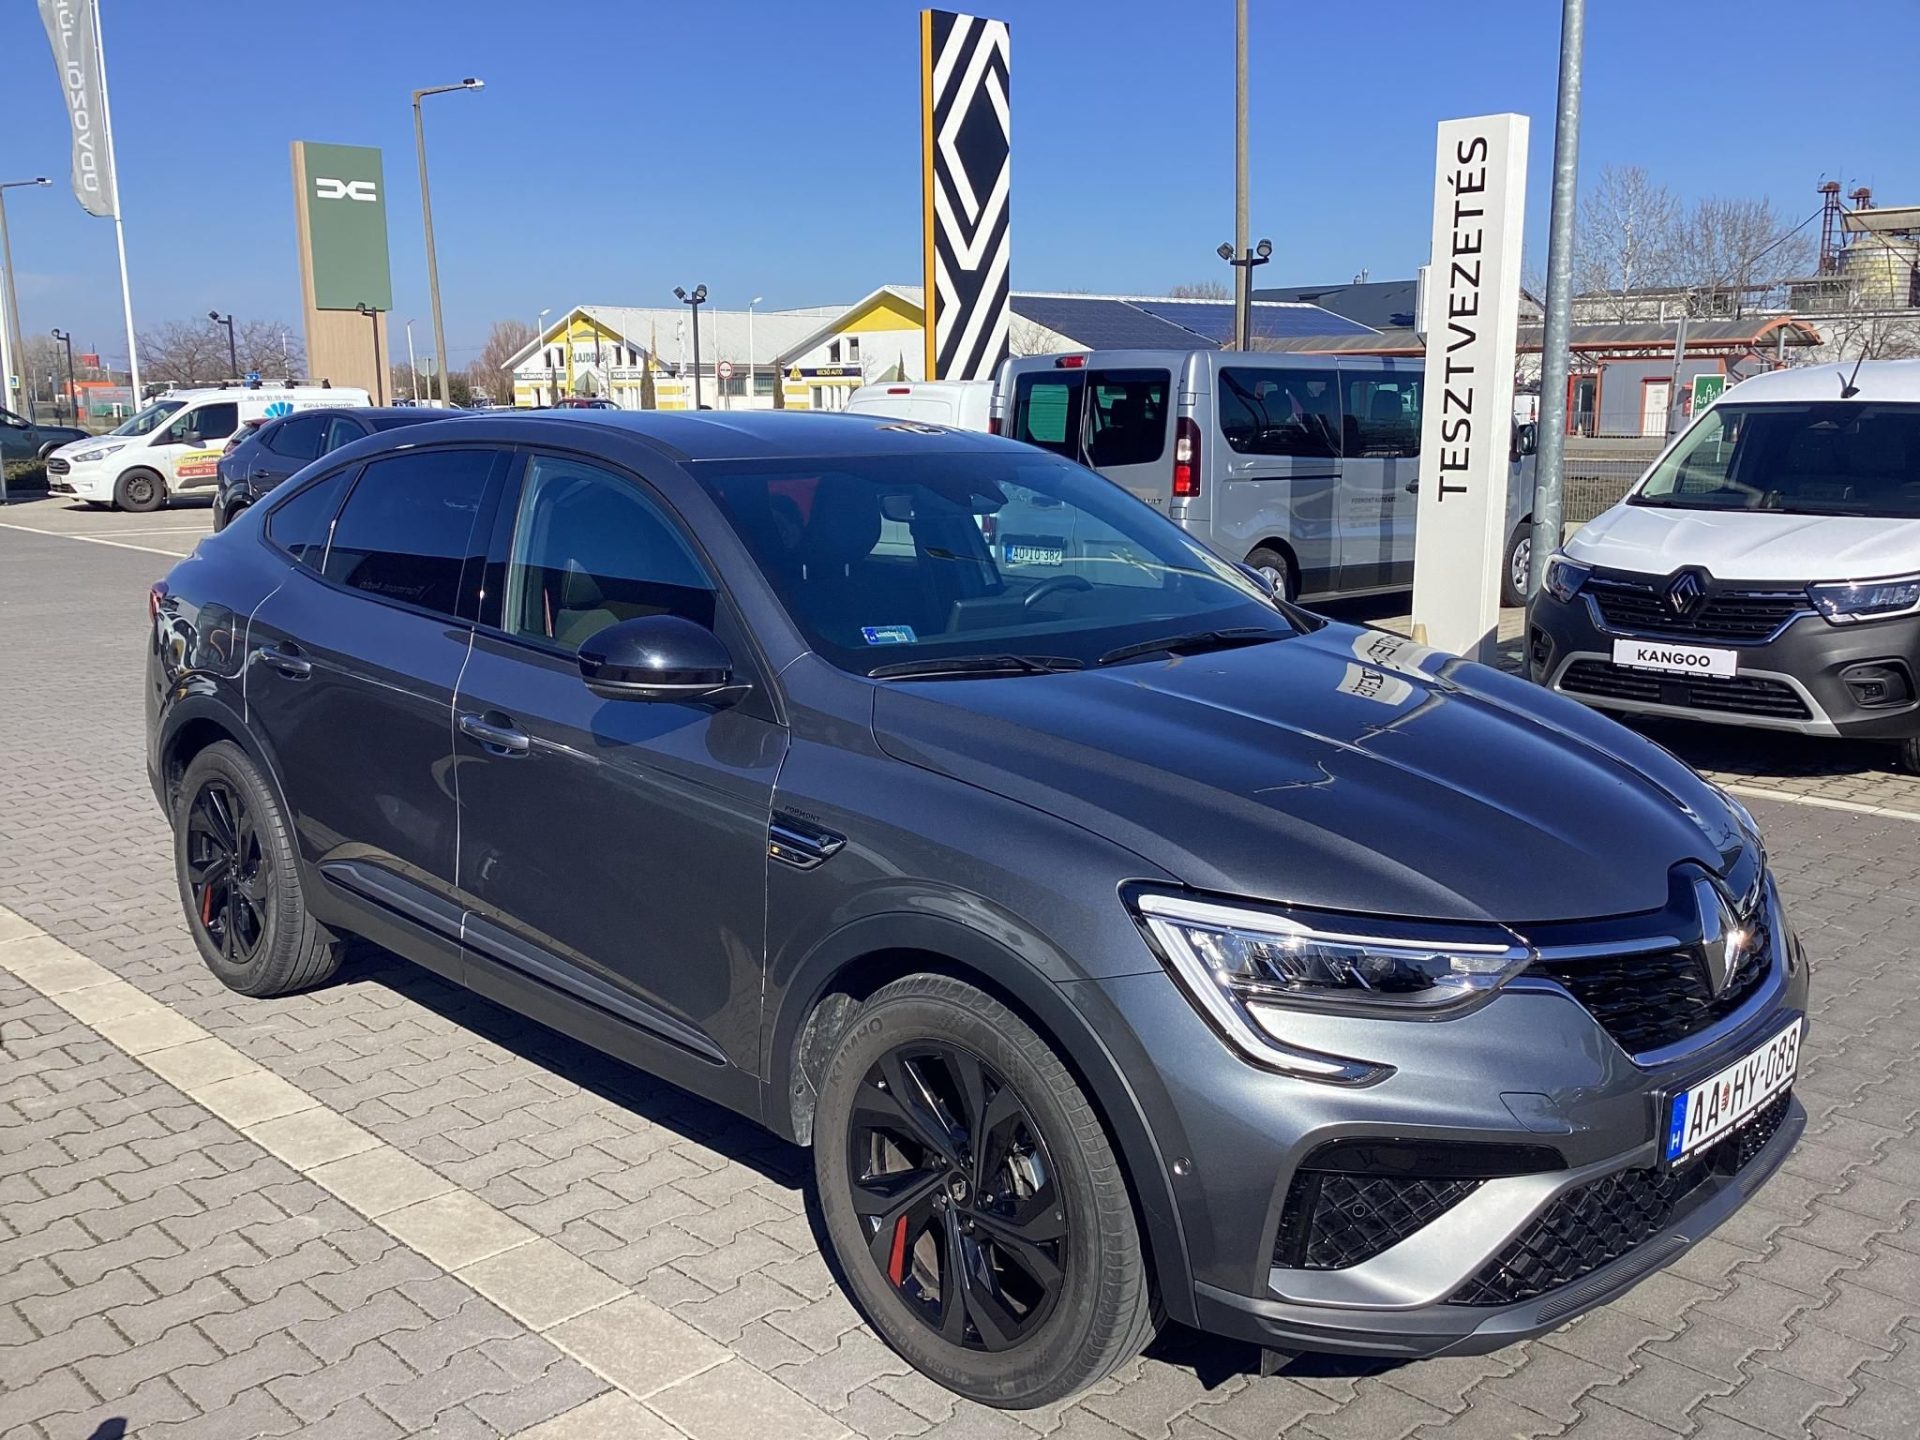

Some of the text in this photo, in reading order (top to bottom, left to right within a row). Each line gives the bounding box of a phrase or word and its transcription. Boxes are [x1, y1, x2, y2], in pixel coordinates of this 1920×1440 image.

[1438, 136, 1488, 502] TESZTVEZETÉS
[1637, 649, 1711, 667] KANGOO
[829, 1017, 884, 1088] KUMHO
